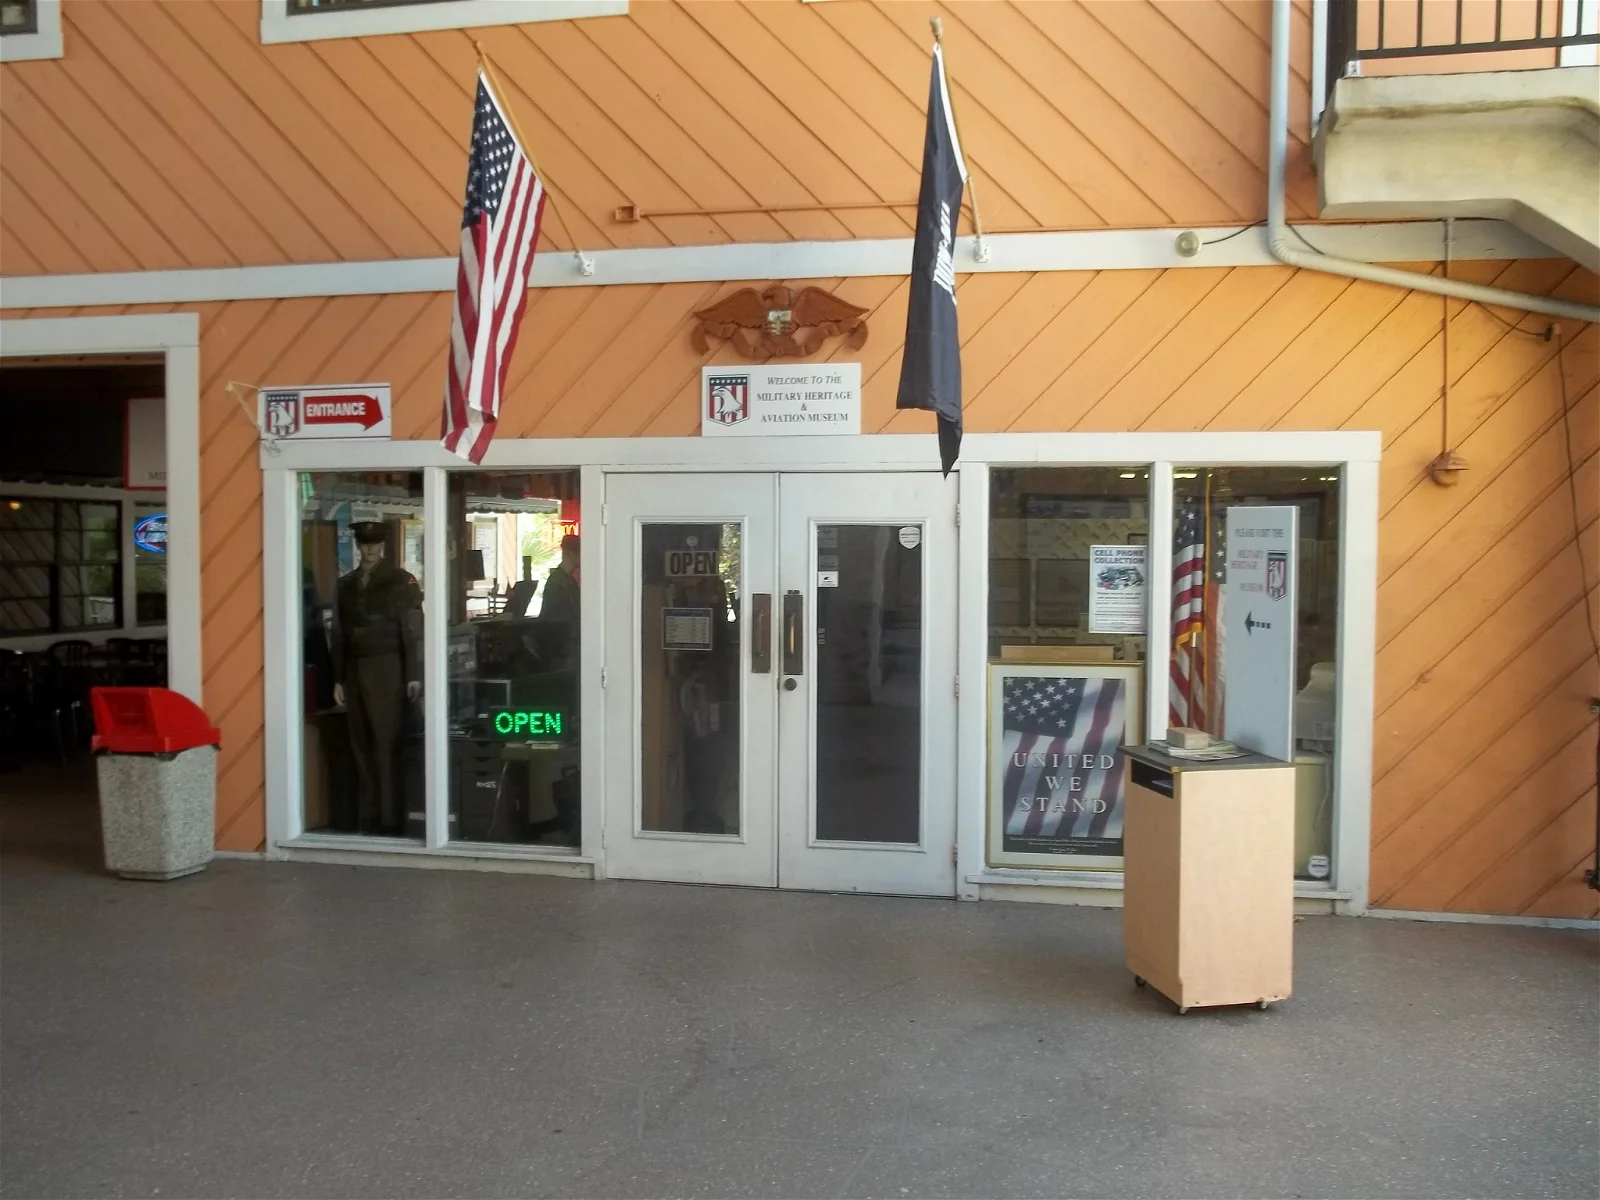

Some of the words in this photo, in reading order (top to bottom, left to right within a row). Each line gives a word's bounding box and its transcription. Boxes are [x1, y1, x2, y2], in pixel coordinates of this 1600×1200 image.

[768, 377, 809, 385] WELCOME
[812, 376, 823, 385] TO
[825, 376, 842, 384] THE
[757, 393, 802, 401] MILITARY
[804, 392, 852, 400] HERITAGE
[306, 402, 366, 417] ENTRANCE
[801, 403, 808, 411] &
[761, 414, 805, 422] AVIATION
[808, 413, 848, 422] MUSEUM
[1094, 549, 1114, 557] CELL
[1116, 549, 1145, 557] PHONE
[669, 551, 717, 576] OPEN
[1094, 557, 1145, 565] COLLECTION
[495, 712, 562, 734] OPEN
[1013, 752, 1115, 769] UNITED
[1045, 776, 1082, 792] WE
[1020, 796, 1107, 814] STAND
